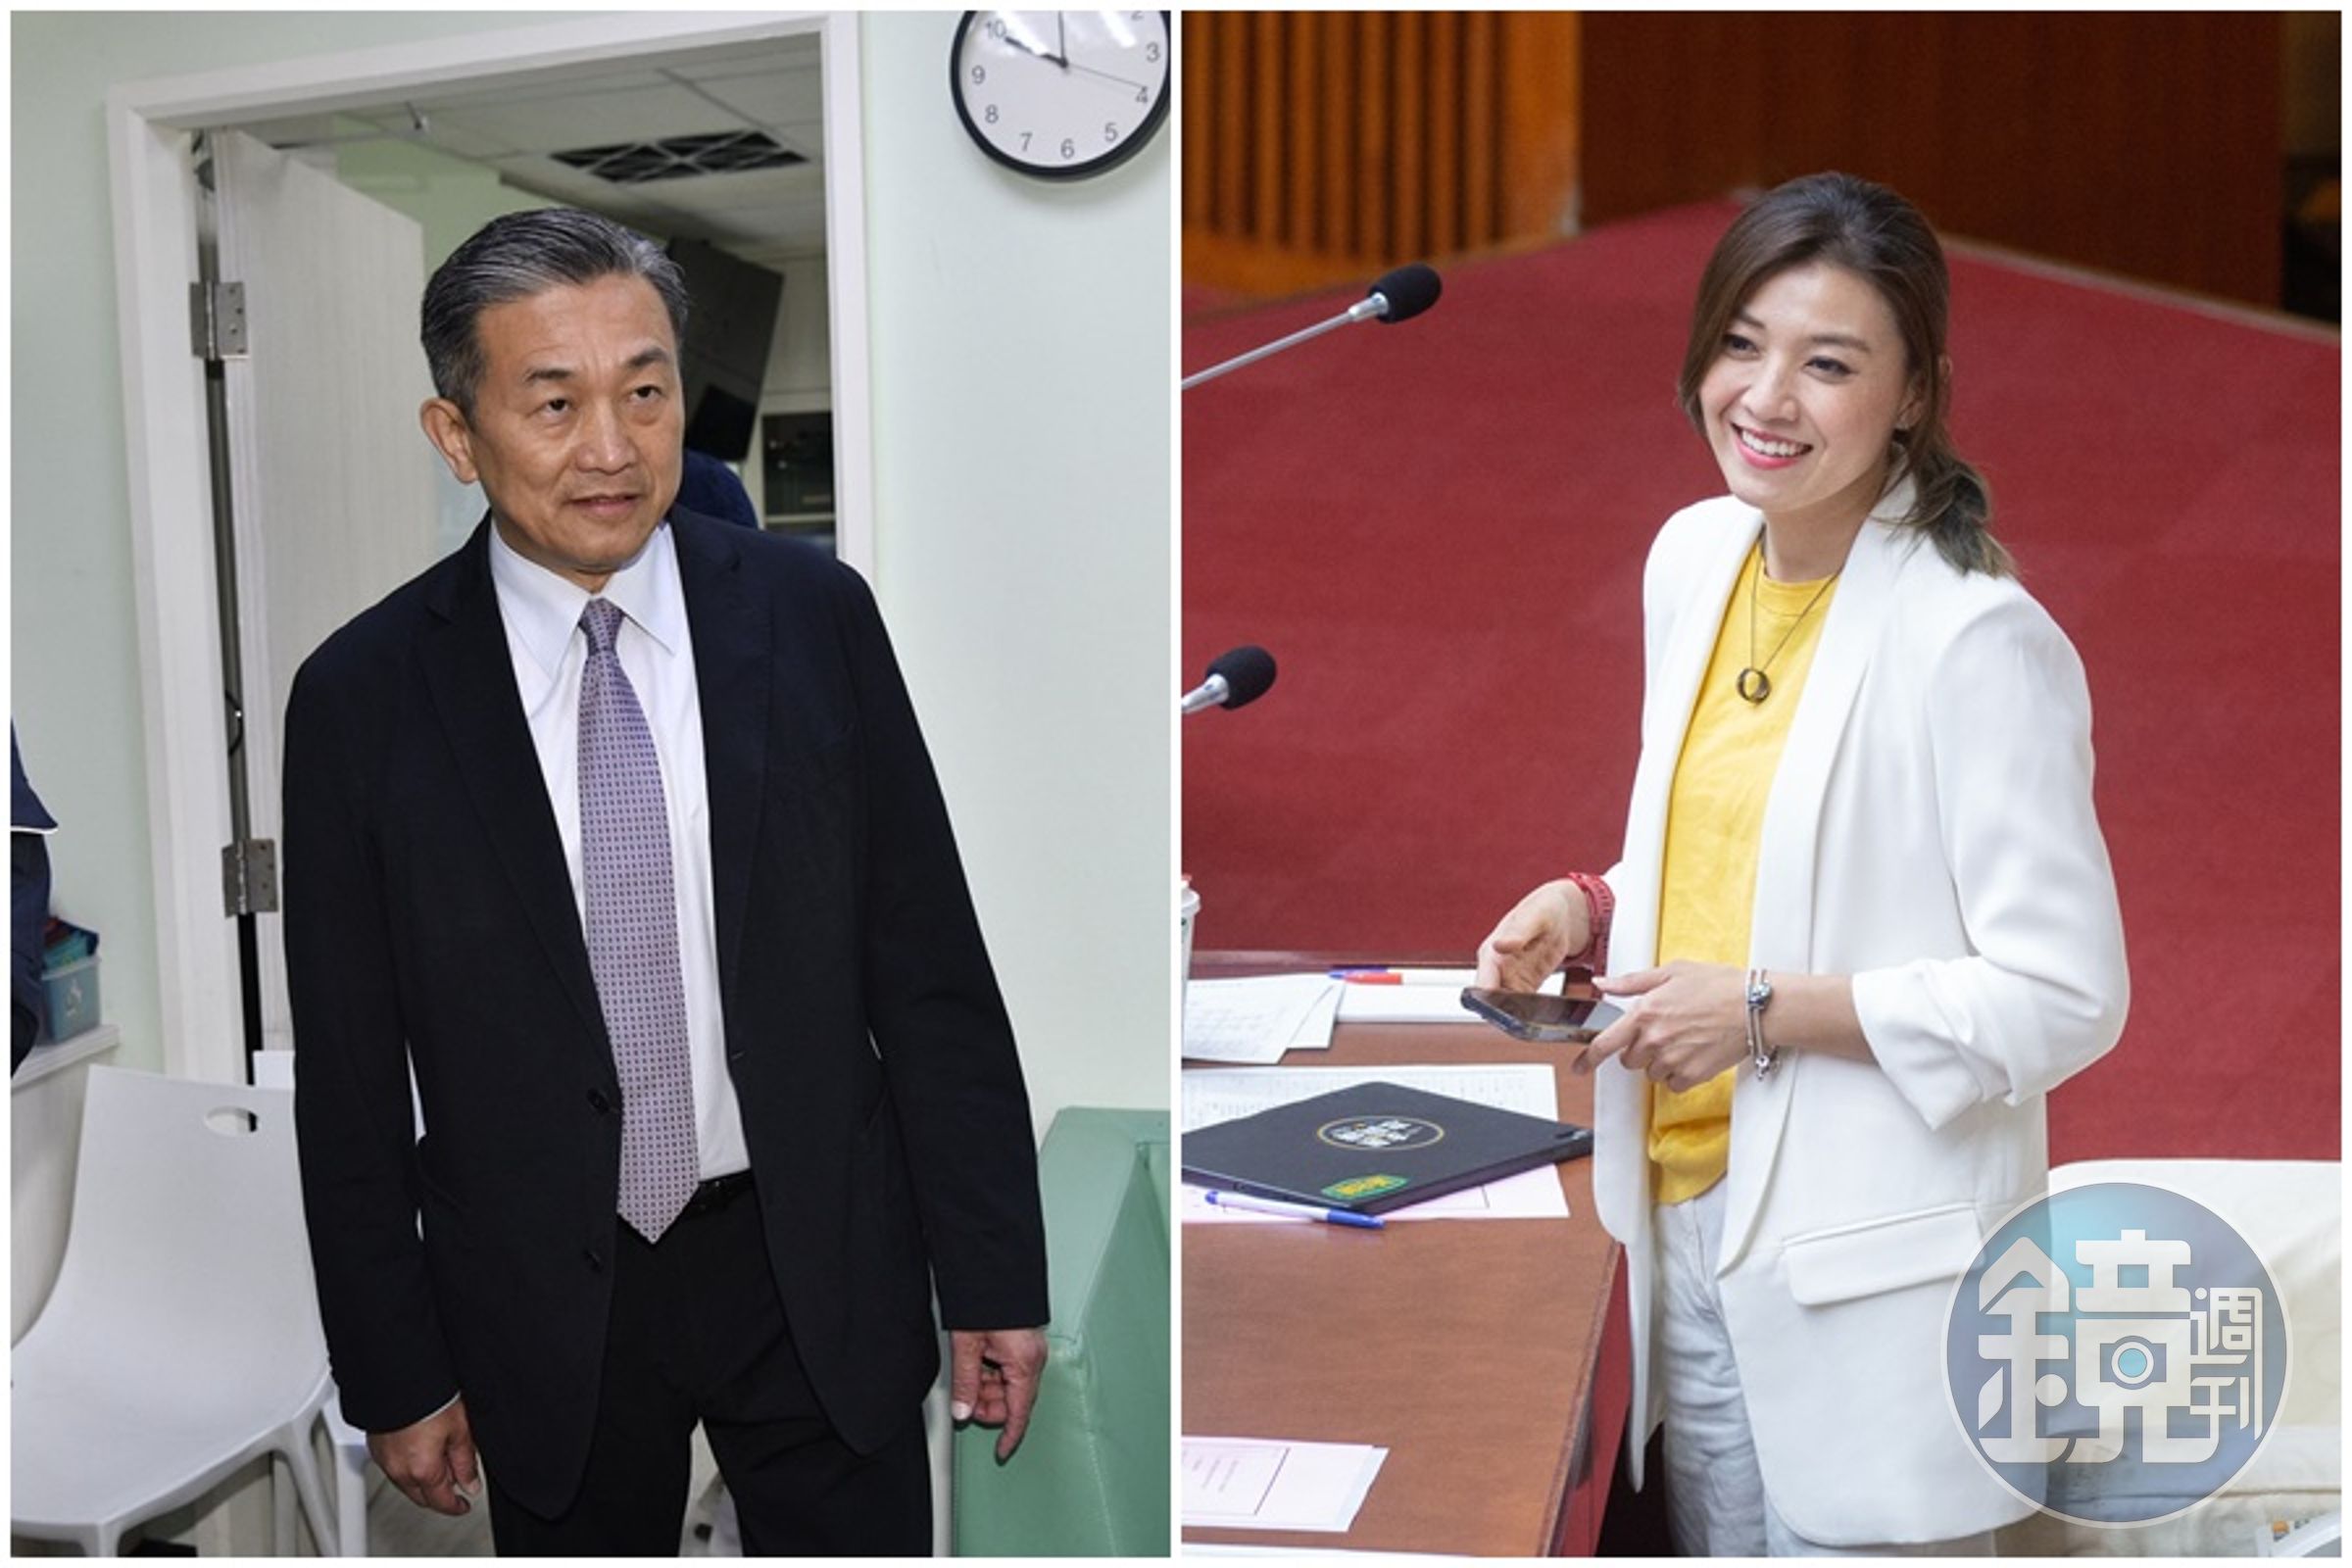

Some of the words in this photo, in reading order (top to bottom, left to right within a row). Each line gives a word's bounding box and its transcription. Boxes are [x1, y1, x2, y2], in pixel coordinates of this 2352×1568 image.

[986, 20, 1006, 39] 10
[1147, 42, 1159, 63] 3
[972, 65, 985, 84] 9
[1136, 85, 1149, 104] 4
[985, 104, 999, 123] 8
[1020, 132, 1032, 151] 7
[1104, 122, 1118, 142] 5
[1061, 138, 1074, 159] 6
